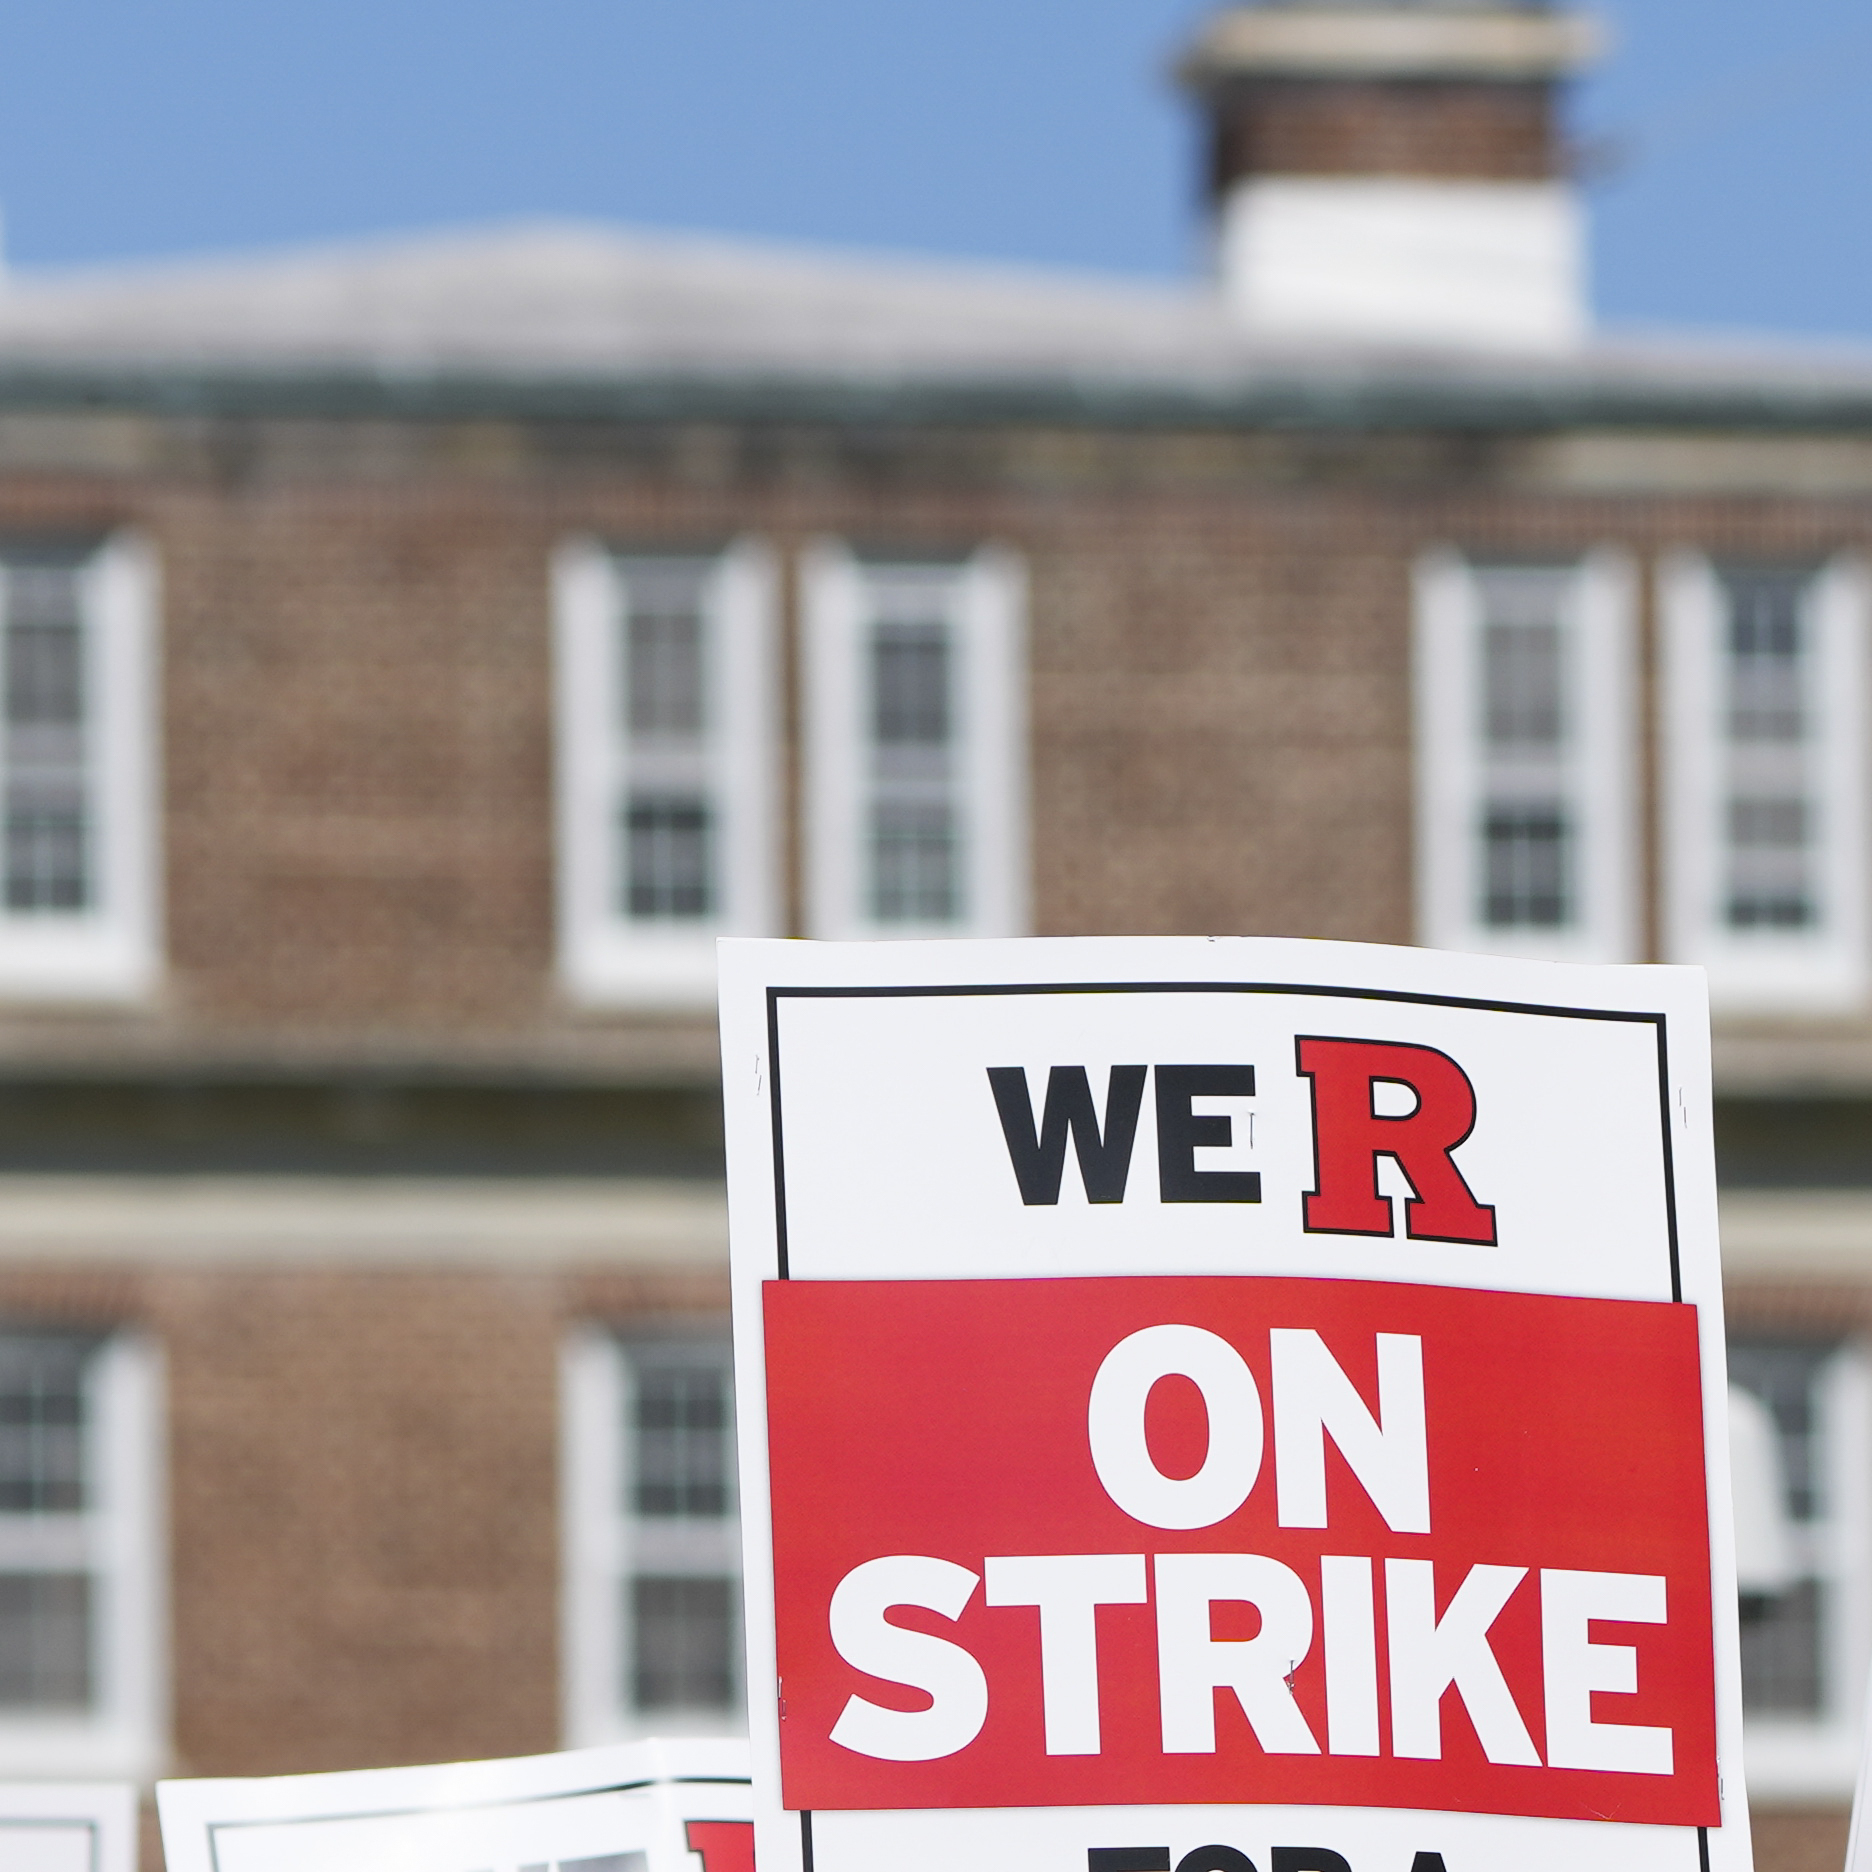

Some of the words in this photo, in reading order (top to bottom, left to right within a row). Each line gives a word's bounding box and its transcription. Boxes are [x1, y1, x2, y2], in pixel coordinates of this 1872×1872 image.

[986, 1064, 1262, 1205] WE
[1295, 1034, 1498, 1247] R
[1087, 1323, 1433, 1534] ON
[827, 1552, 1675, 1775] STRIKE
